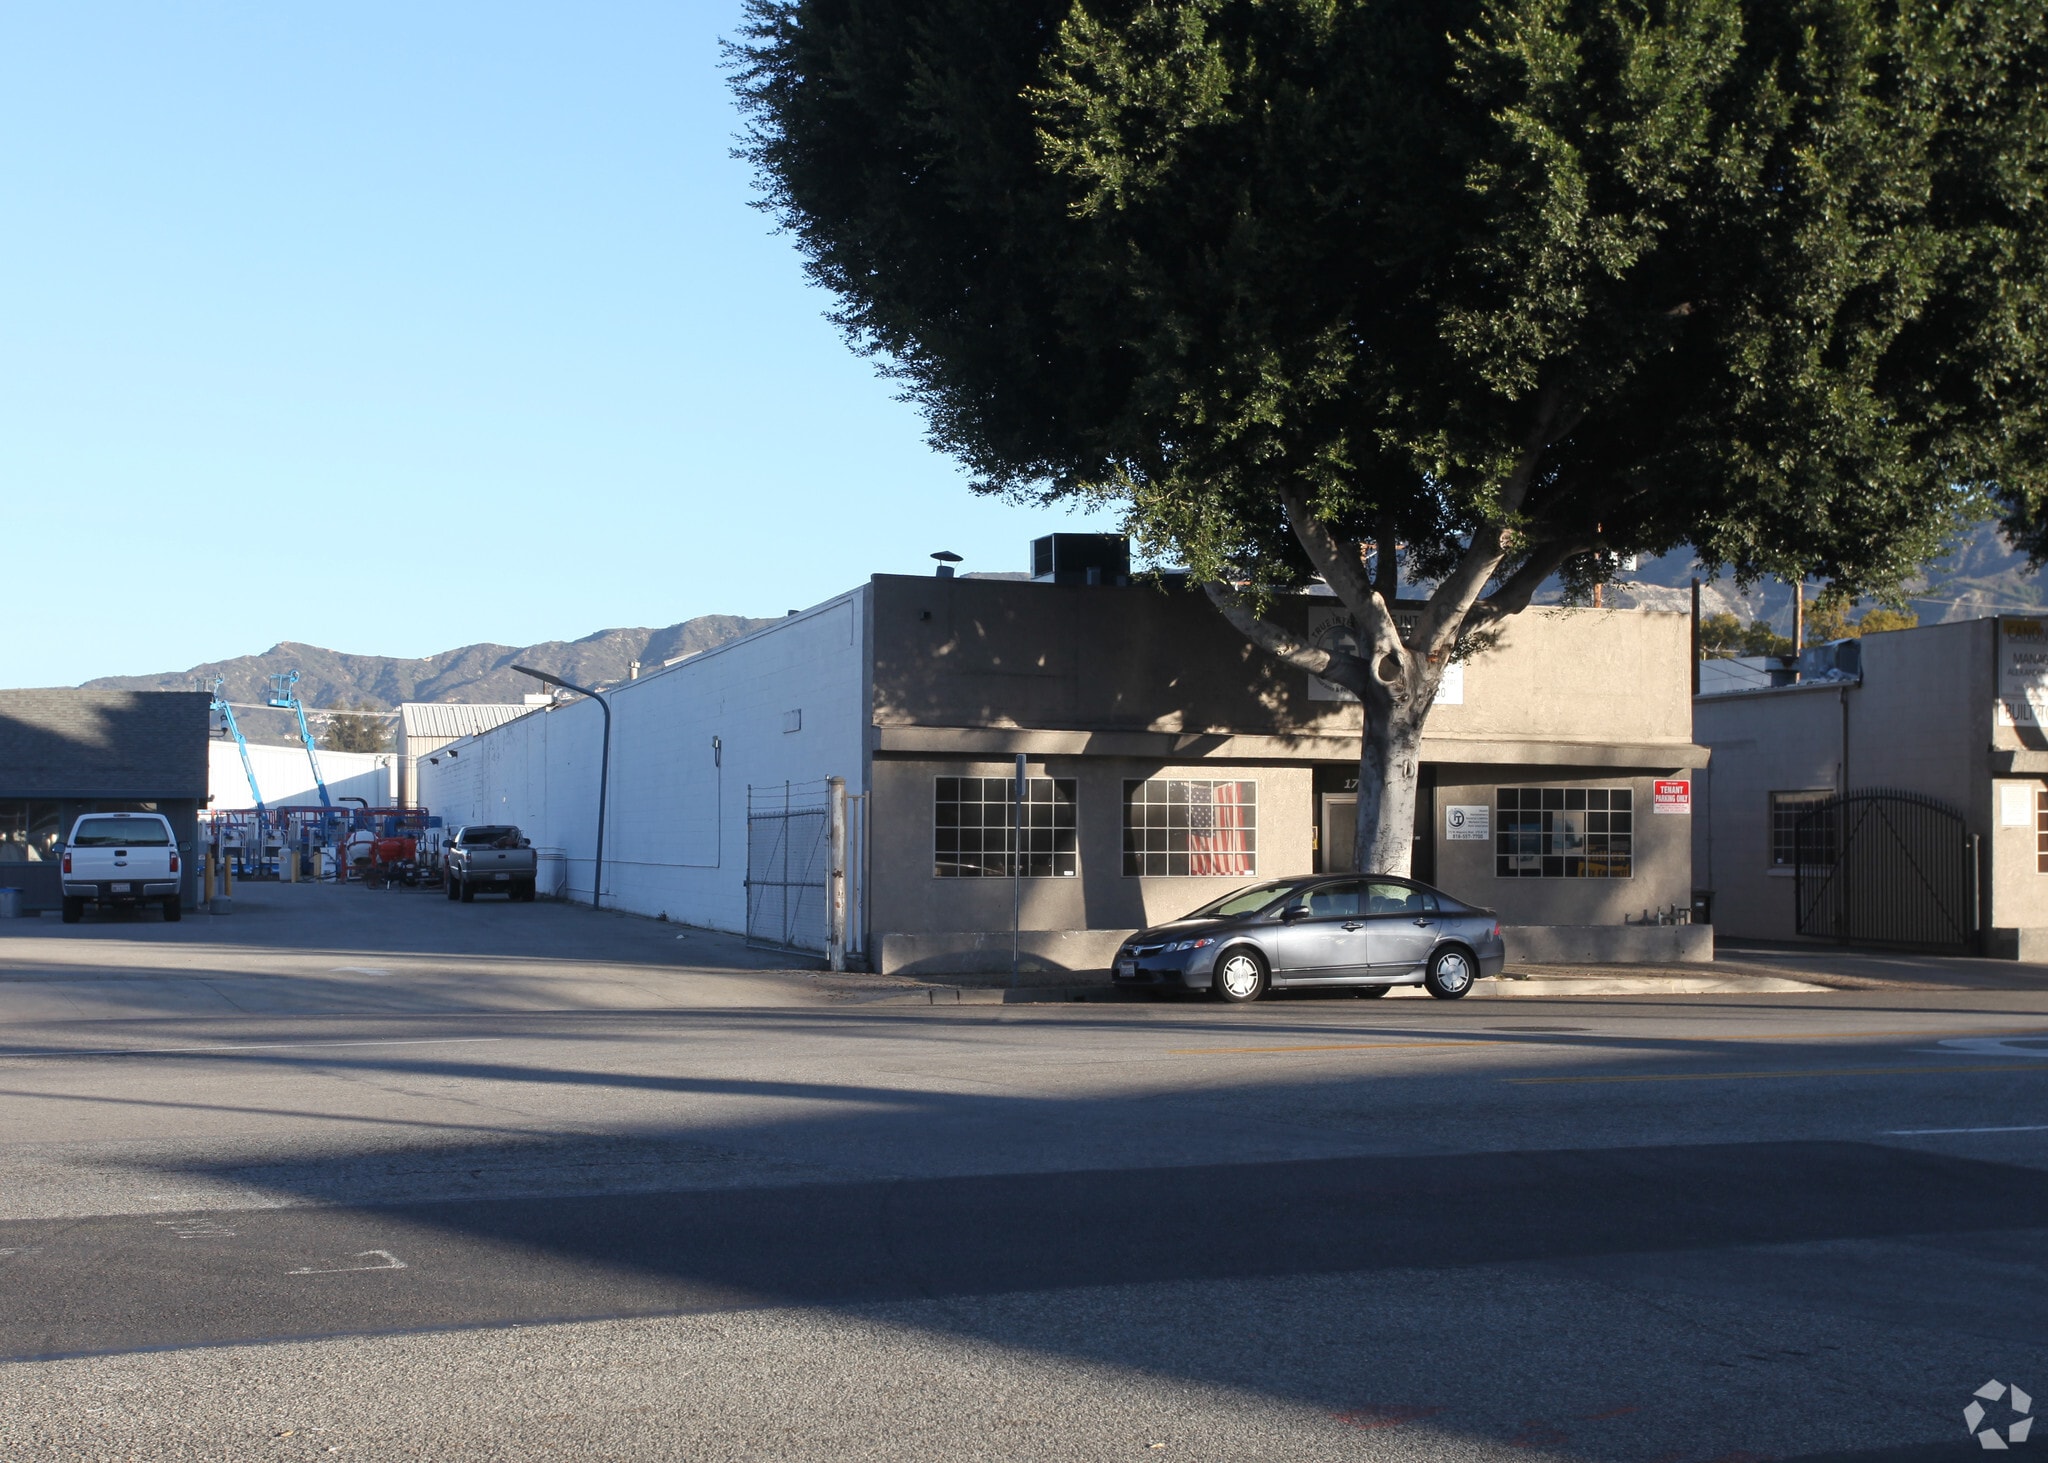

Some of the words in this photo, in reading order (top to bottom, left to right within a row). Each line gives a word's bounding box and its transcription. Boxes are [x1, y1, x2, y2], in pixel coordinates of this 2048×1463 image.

[1311, 618, 1332, 639] TRUE
[2013, 652, 2048, 665] MANAG
[2005, 703, 2034, 721] BUILT
[1344, 779, 1360, 789] 17
[1660, 785, 1684, 794] TENANT
[1655, 794, 1676, 803] PARKING
[1676, 794, 1688, 803] ONLY
